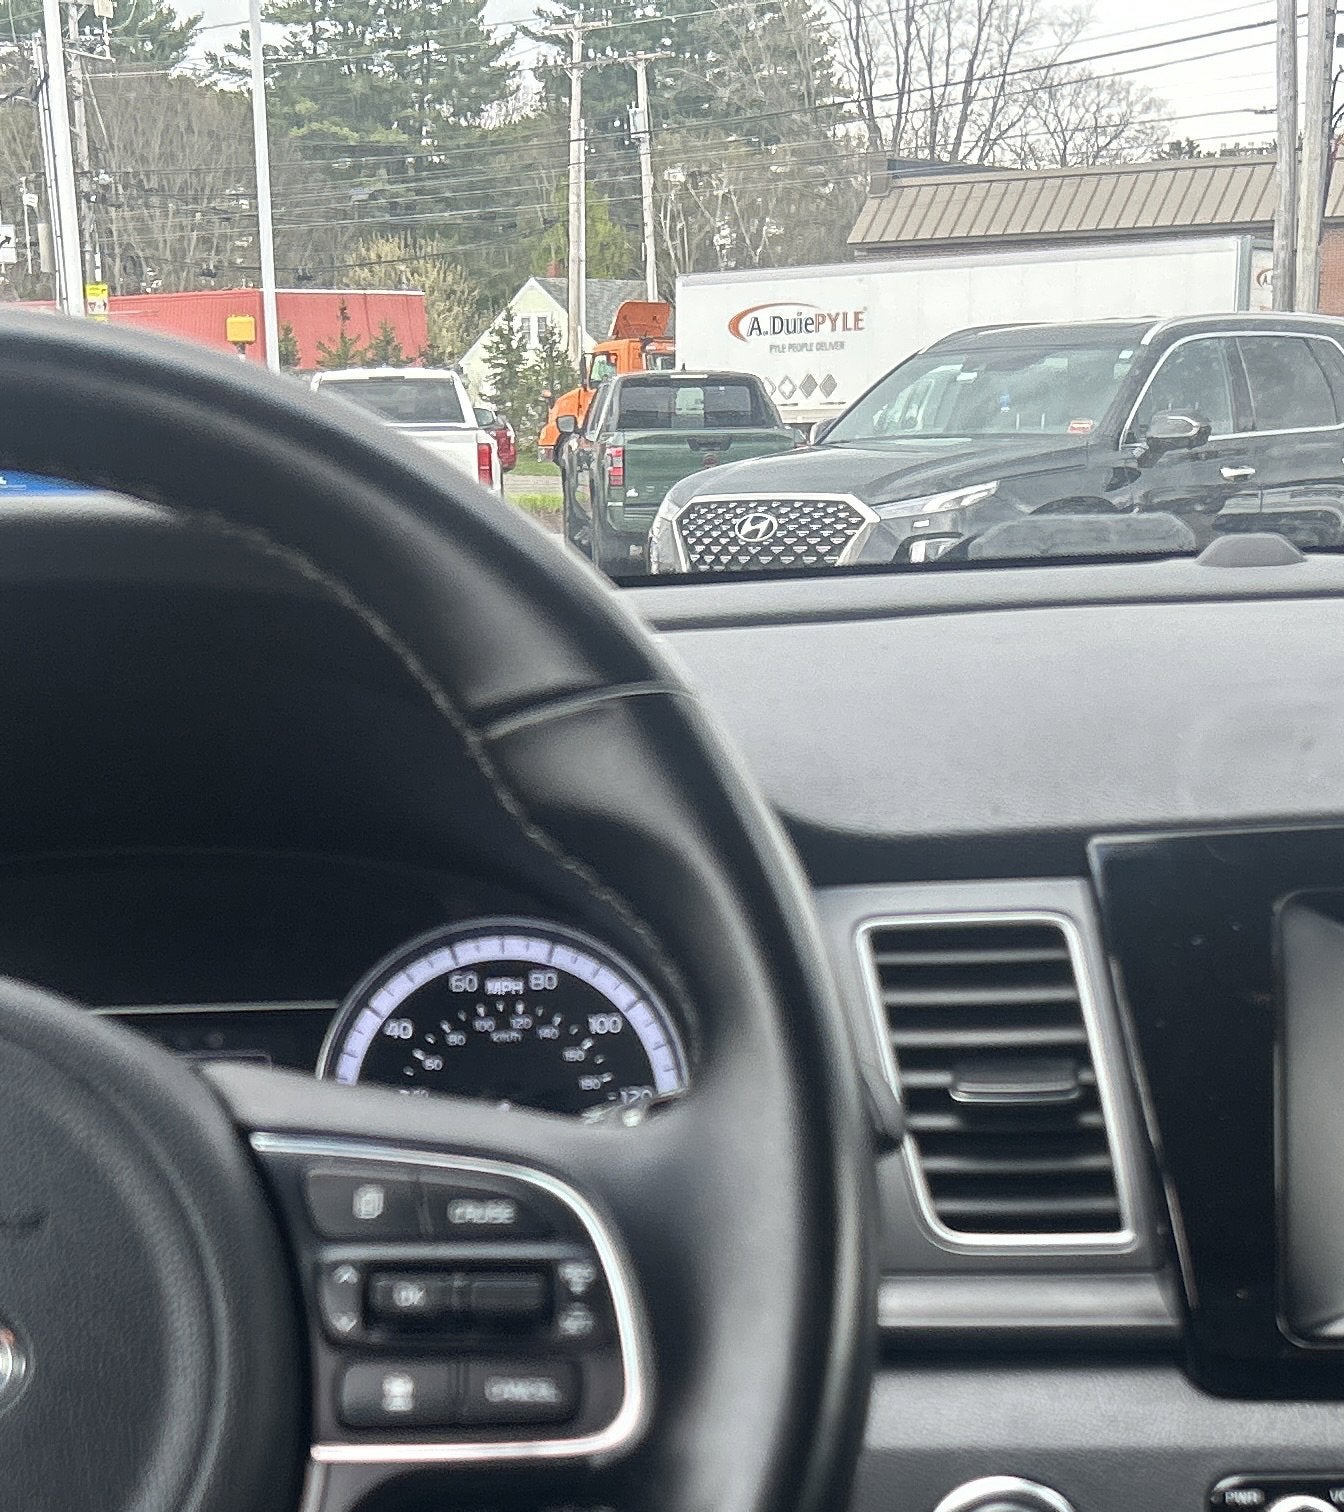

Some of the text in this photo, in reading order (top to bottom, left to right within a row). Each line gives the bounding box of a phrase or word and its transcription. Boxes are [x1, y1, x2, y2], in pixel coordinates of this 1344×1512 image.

[449, 970, 478, 993] 60
[484, 976, 524, 995] MPH
[528, 969, 558, 990] 80
[384, 1018, 413, 1040] 40
[588, 1012, 623, 1034] 100
